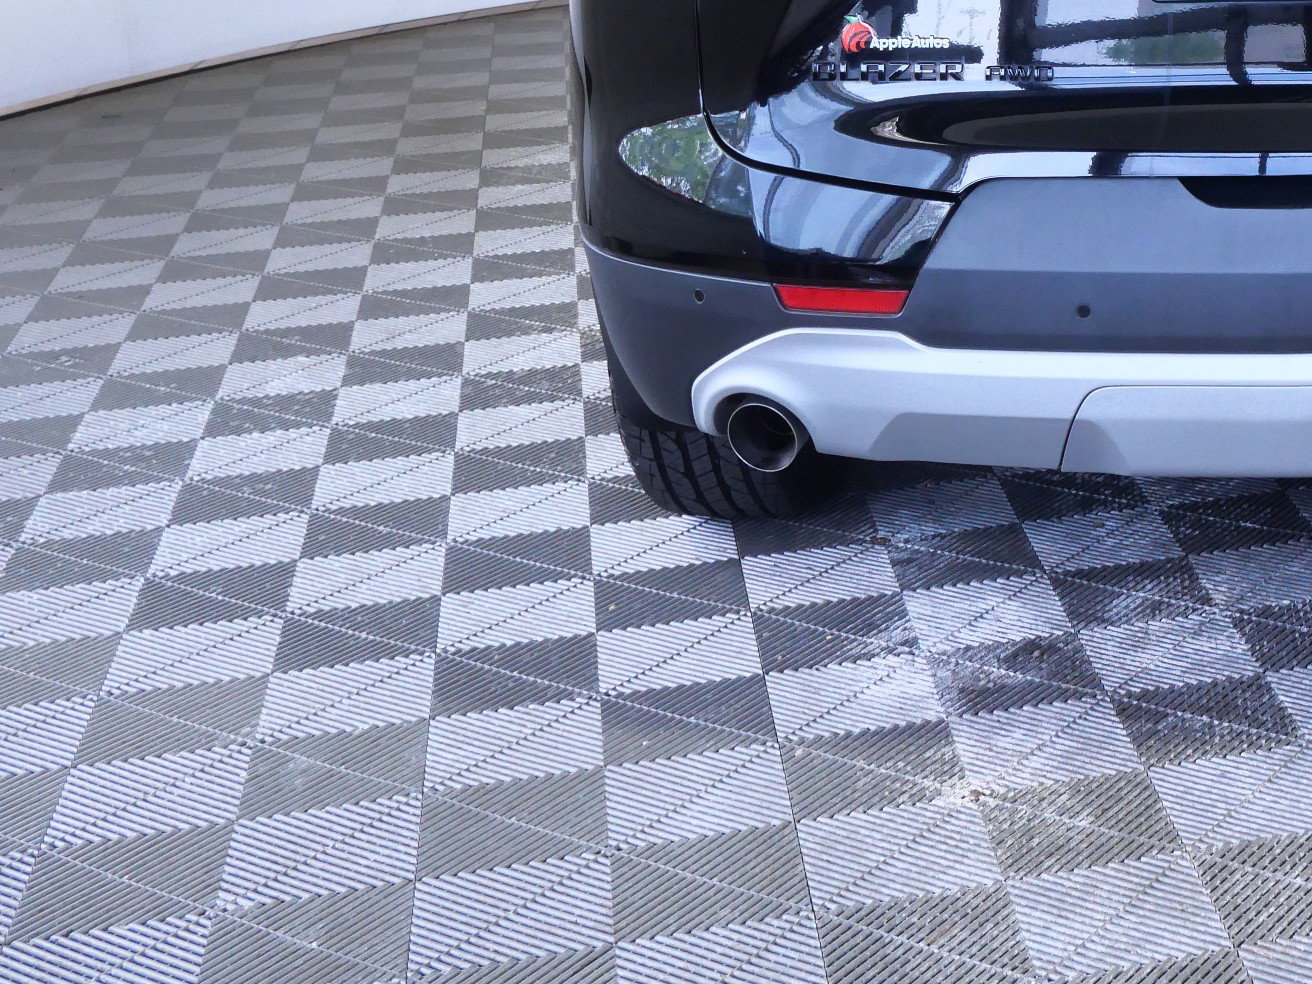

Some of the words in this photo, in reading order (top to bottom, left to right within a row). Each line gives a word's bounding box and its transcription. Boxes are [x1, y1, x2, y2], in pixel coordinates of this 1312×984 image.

[869, 36, 911, 50] Apple
[911, 35, 950, 49] Autos
[811, 61, 964, 82] BLAZER
[985, 65, 1054, 81] AWD
